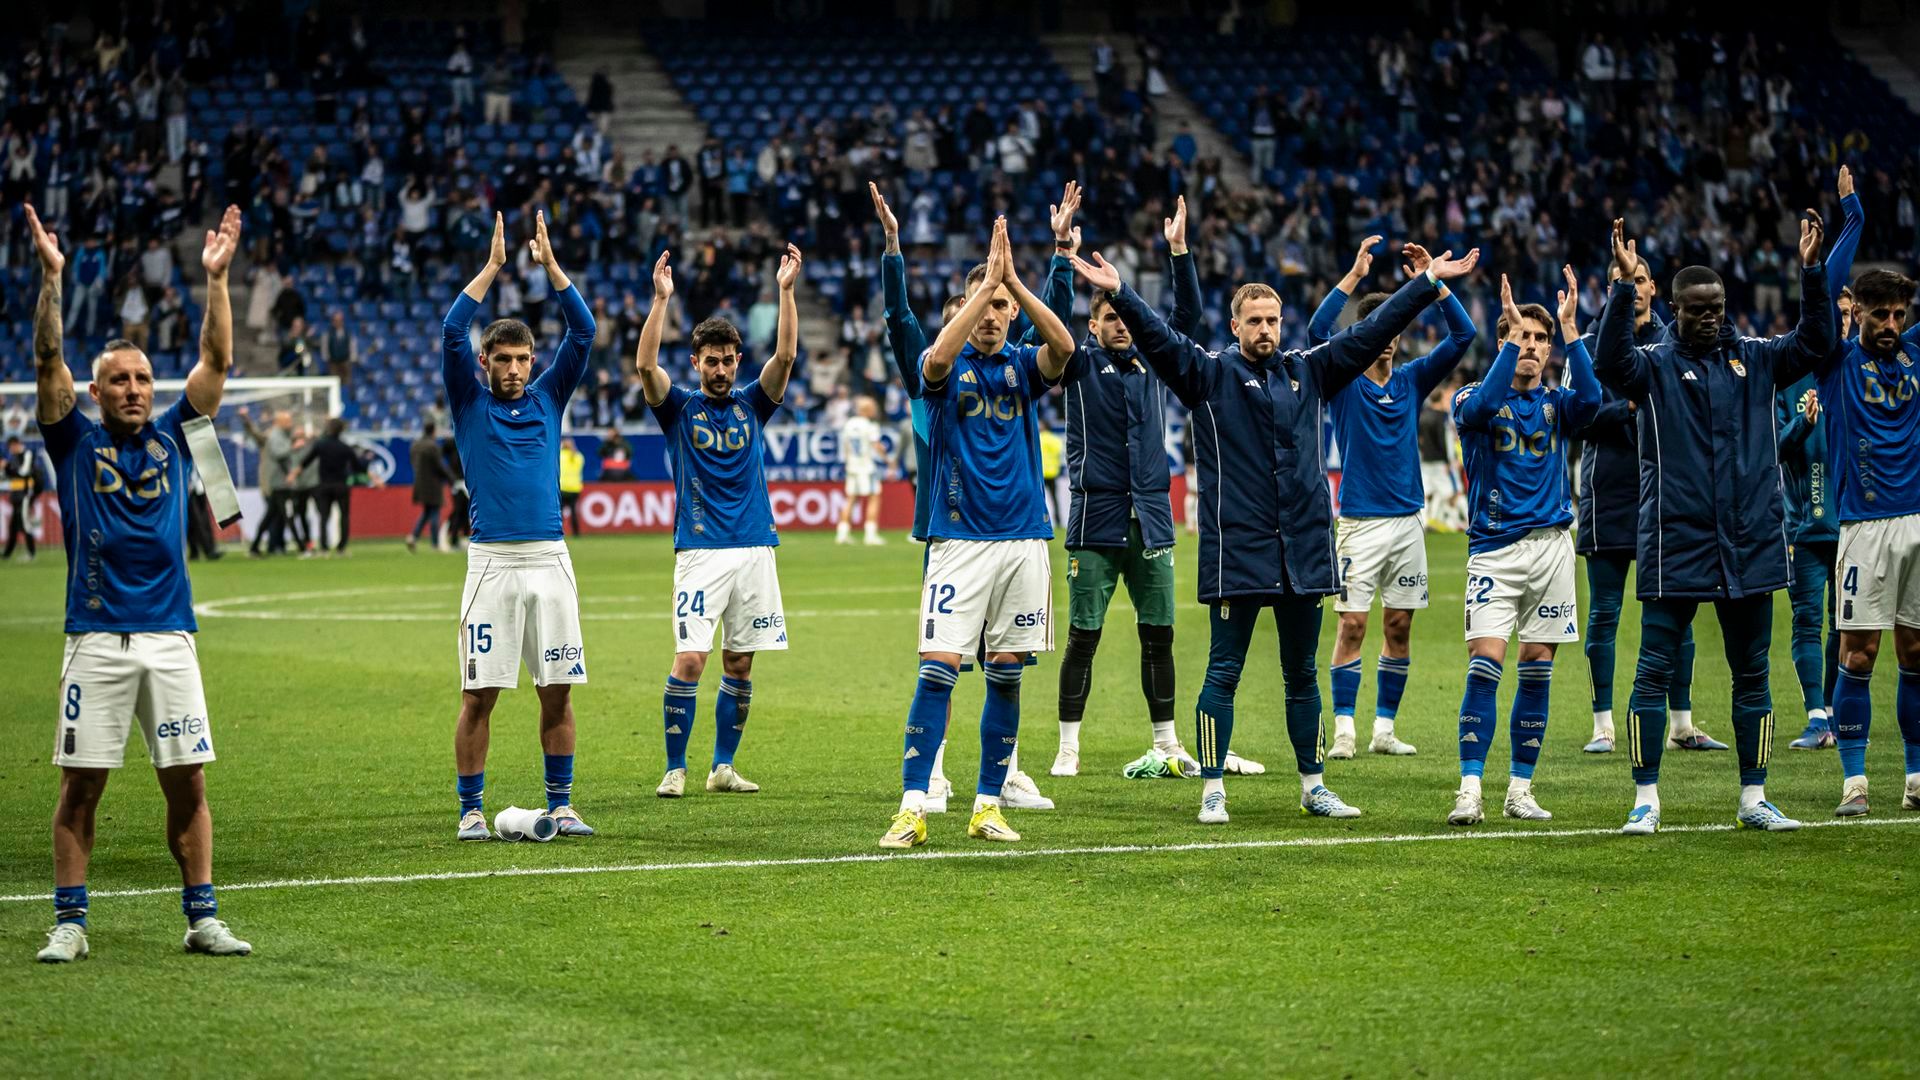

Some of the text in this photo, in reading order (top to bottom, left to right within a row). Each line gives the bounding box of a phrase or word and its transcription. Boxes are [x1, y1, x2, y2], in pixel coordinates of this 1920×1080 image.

[960, 391, 1023, 420] DIGI
[693, 423, 751, 451] DIGI
[1812, 463, 1820, 504] OVIEDO
[1843, 566, 1858, 596] 4
[677, 590, 705, 618] 24
[929, 583, 956, 614] 12
[468, 623, 493, 654] 15
[65, 683, 81, 721] 8
